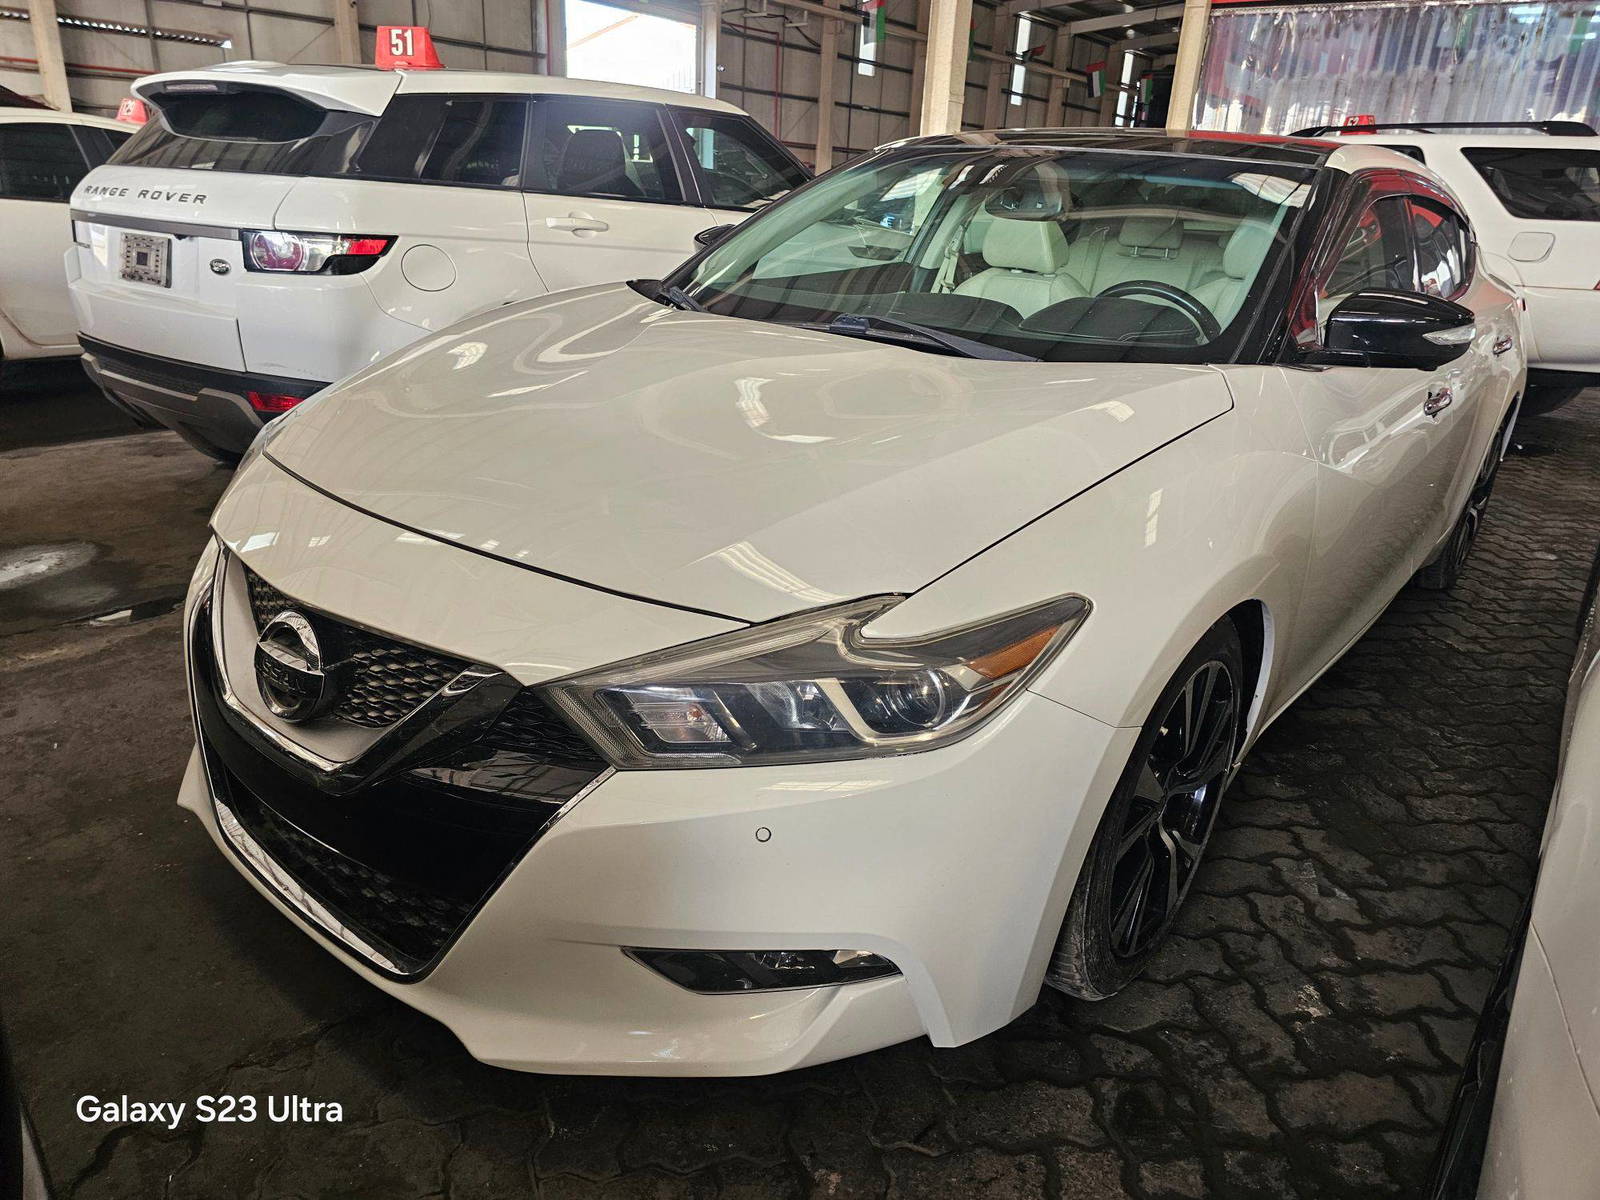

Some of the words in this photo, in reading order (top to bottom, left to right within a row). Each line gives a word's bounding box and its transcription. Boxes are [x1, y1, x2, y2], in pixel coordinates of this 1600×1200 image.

[390, 28, 414, 57] 51
[84, 185, 129, 198] RANGE
[137, 189, 208, 205] ROVER
